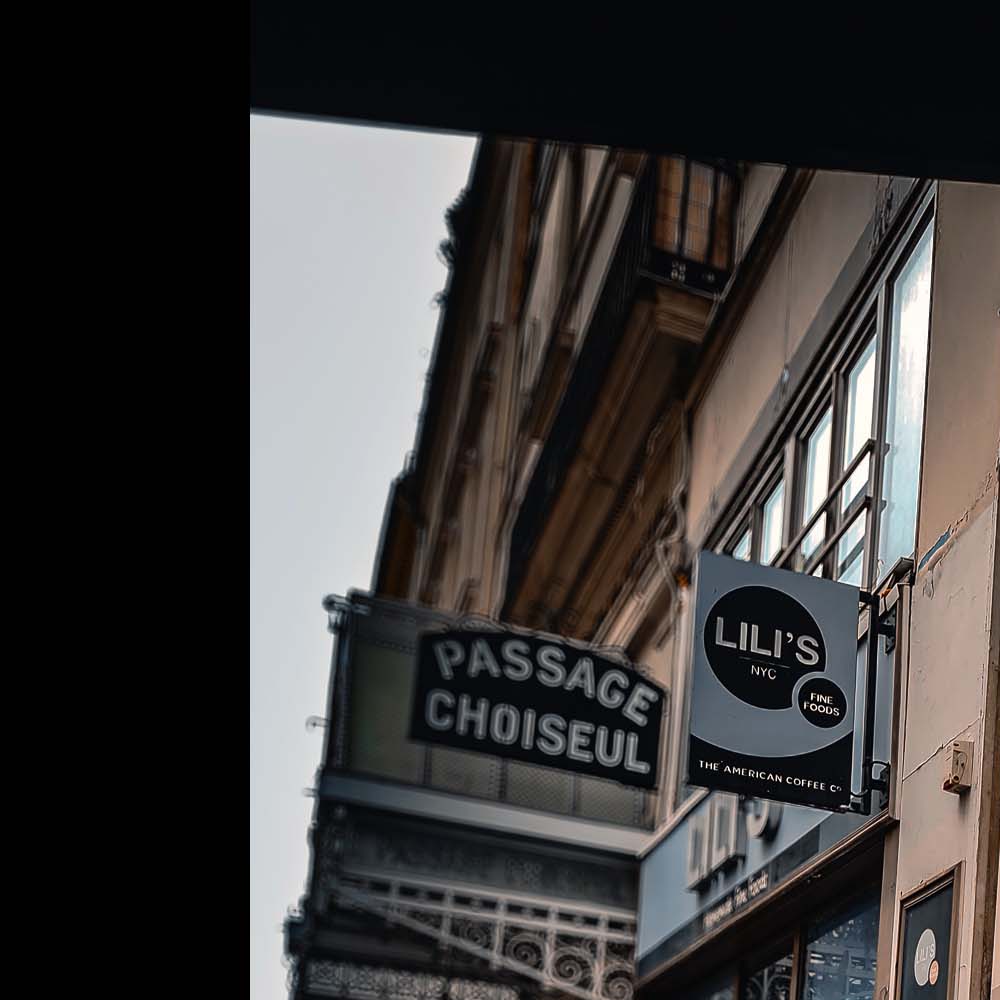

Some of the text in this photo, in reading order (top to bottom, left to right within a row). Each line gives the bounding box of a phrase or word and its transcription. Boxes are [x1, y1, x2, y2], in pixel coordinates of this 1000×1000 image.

[715, 616, 820, 666] LILI'S
[433, 638, 660, 728] PASSAGE
[751, 664, 777, 680] NYC
[803, 701, 840, 717] FOODS
[810, 692, 833, 705] FINE
[424, 688, 651, 774] CHOISEUL
[699, 760, 719, 771] THE
[723, 765, 782, 783] AMERICAN
[786, 776, 826, 791] COFFEE
